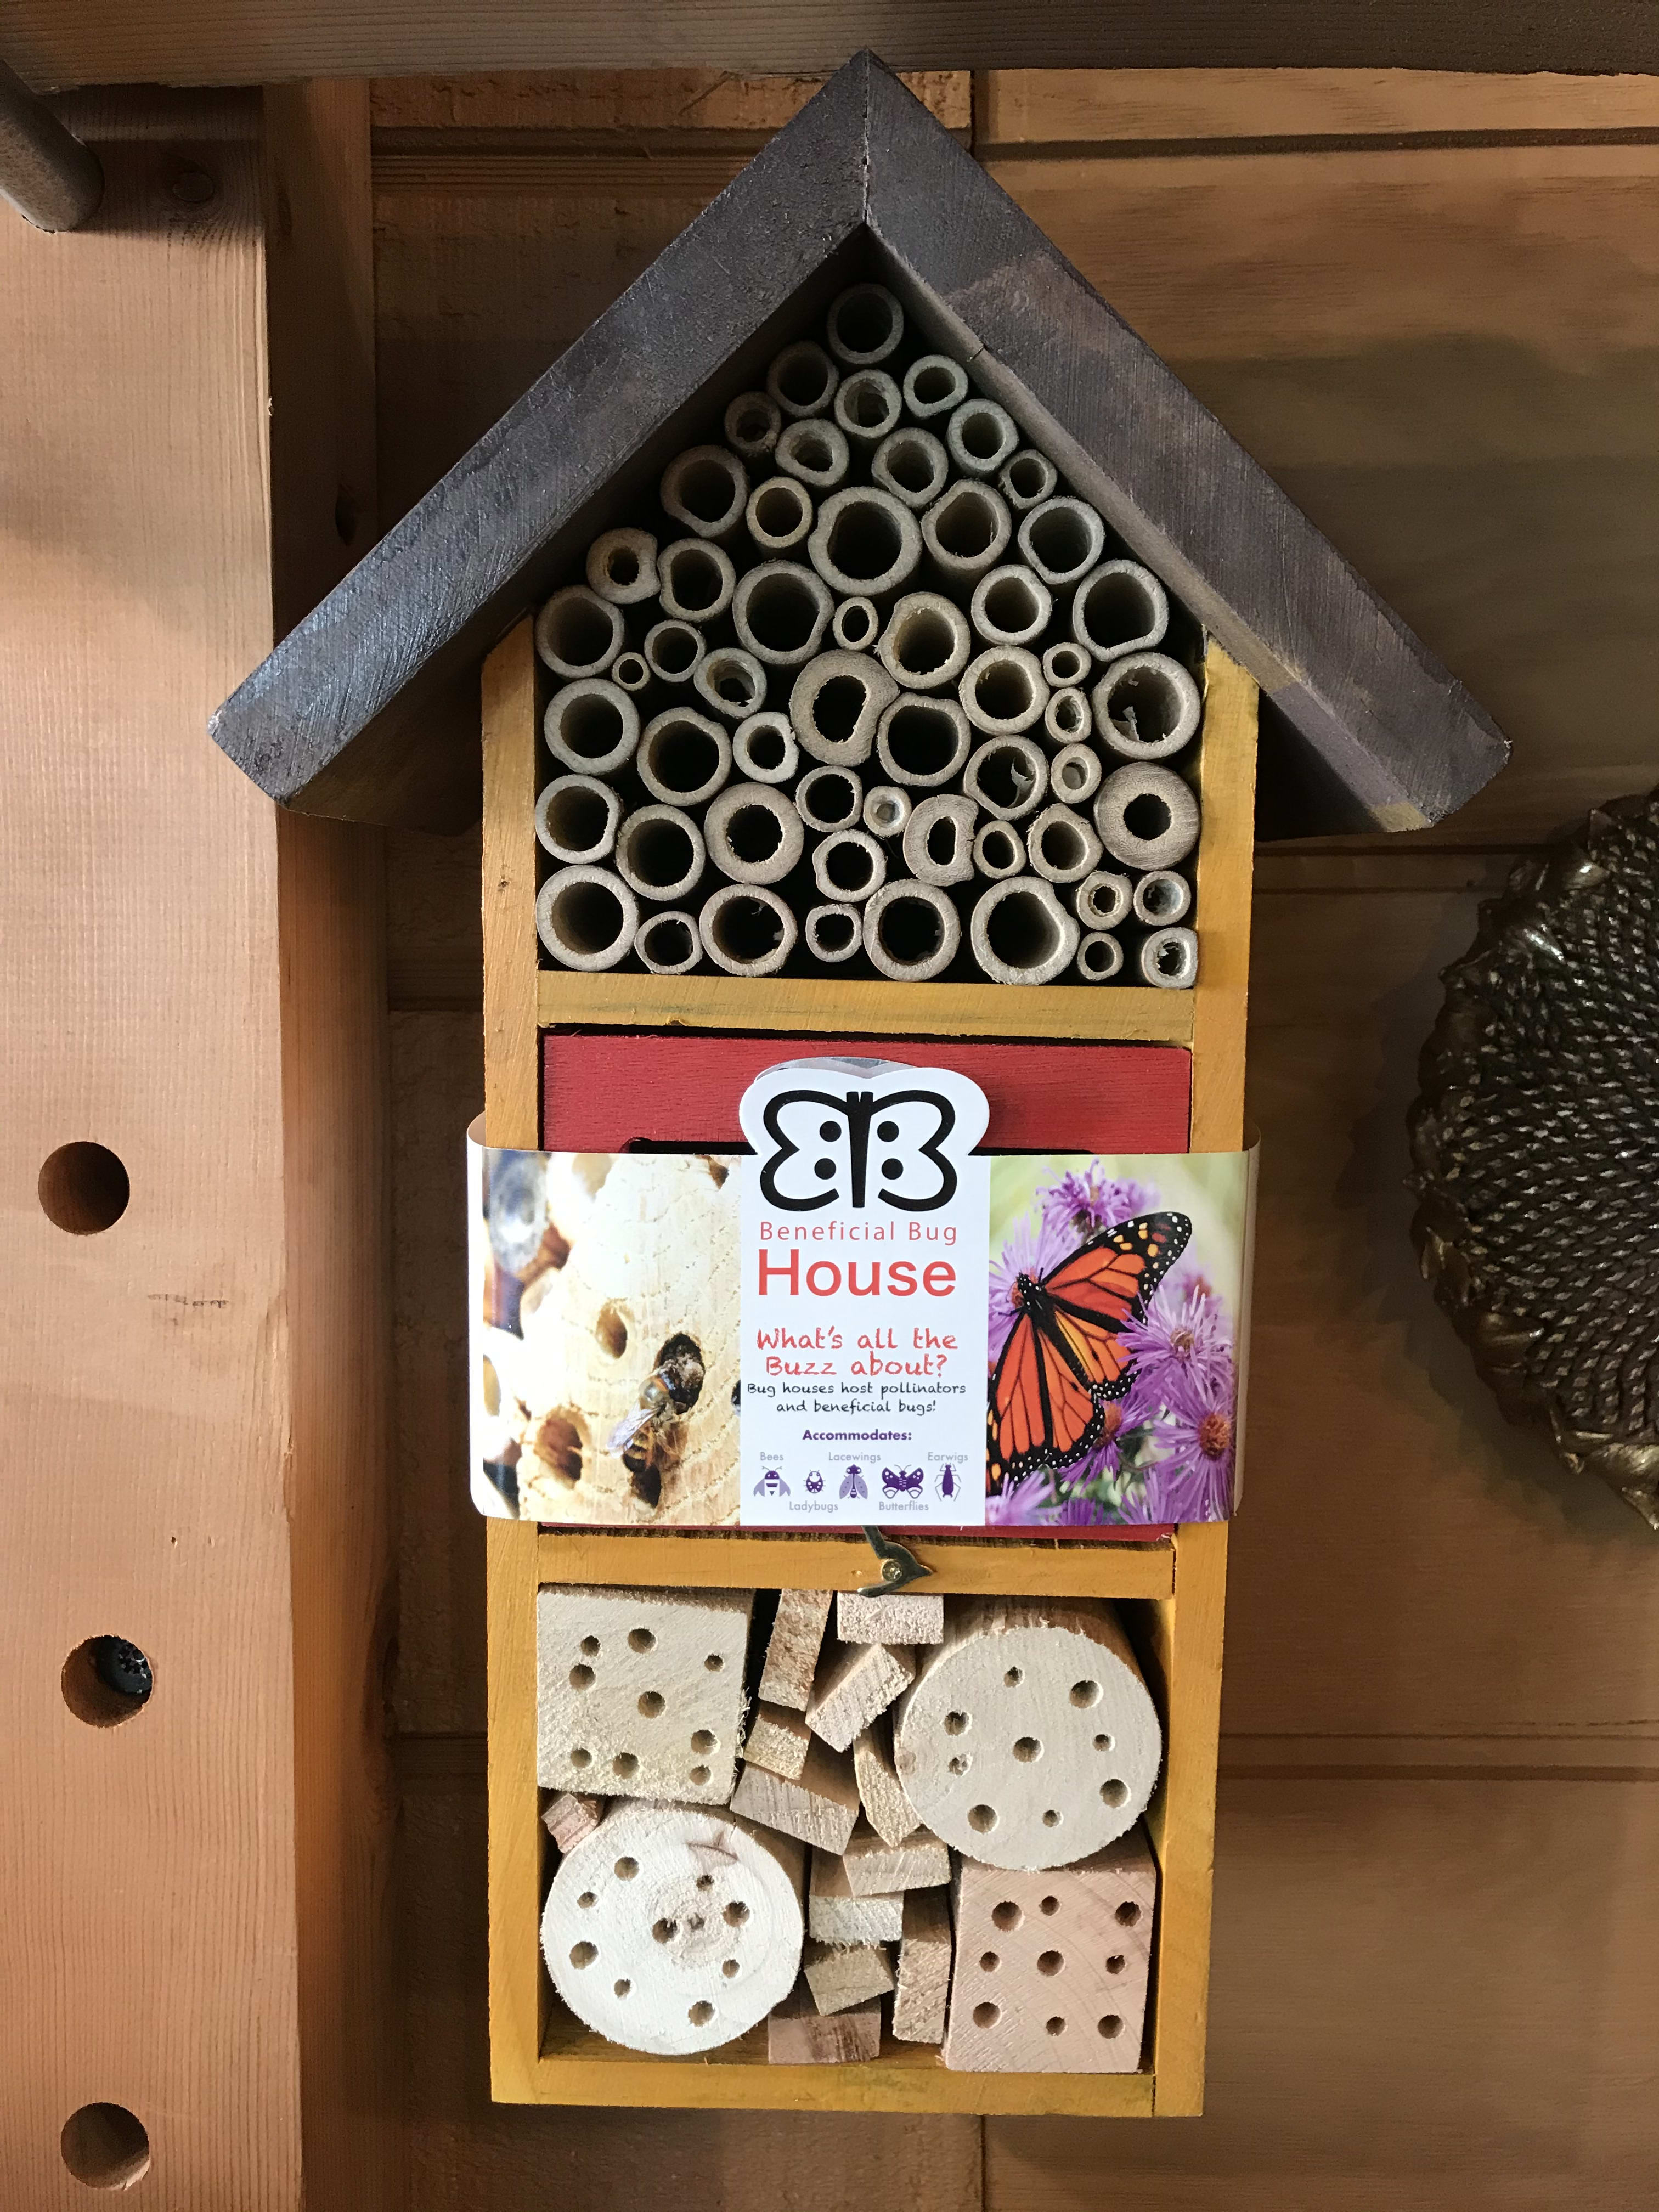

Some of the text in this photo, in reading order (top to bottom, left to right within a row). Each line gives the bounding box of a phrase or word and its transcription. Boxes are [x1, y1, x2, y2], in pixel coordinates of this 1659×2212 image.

[760, 1221, 957, 1246] Beneficial Bug
[759, 1249, 956, 1297] House
[757, 1325, 958, 1350] What's all the
[766, 1351, 947, 1378] Buzz about?
[747, 1382, 966, 1399] Bug houses host pollinators
[776, 1398, 936, 1416] and beneficial bugs!
[802, 1429, 912, 1441] Accommodates:
[760, 1452, 784, 1461] Bees
[828, 1452, 881, 1464] Lacewings
[928, 1452, 969, 1464] Earwigs
[789, 1501, 838, 1513] Ladybugs
[879, 1501, 929, 1511] Butterflies
